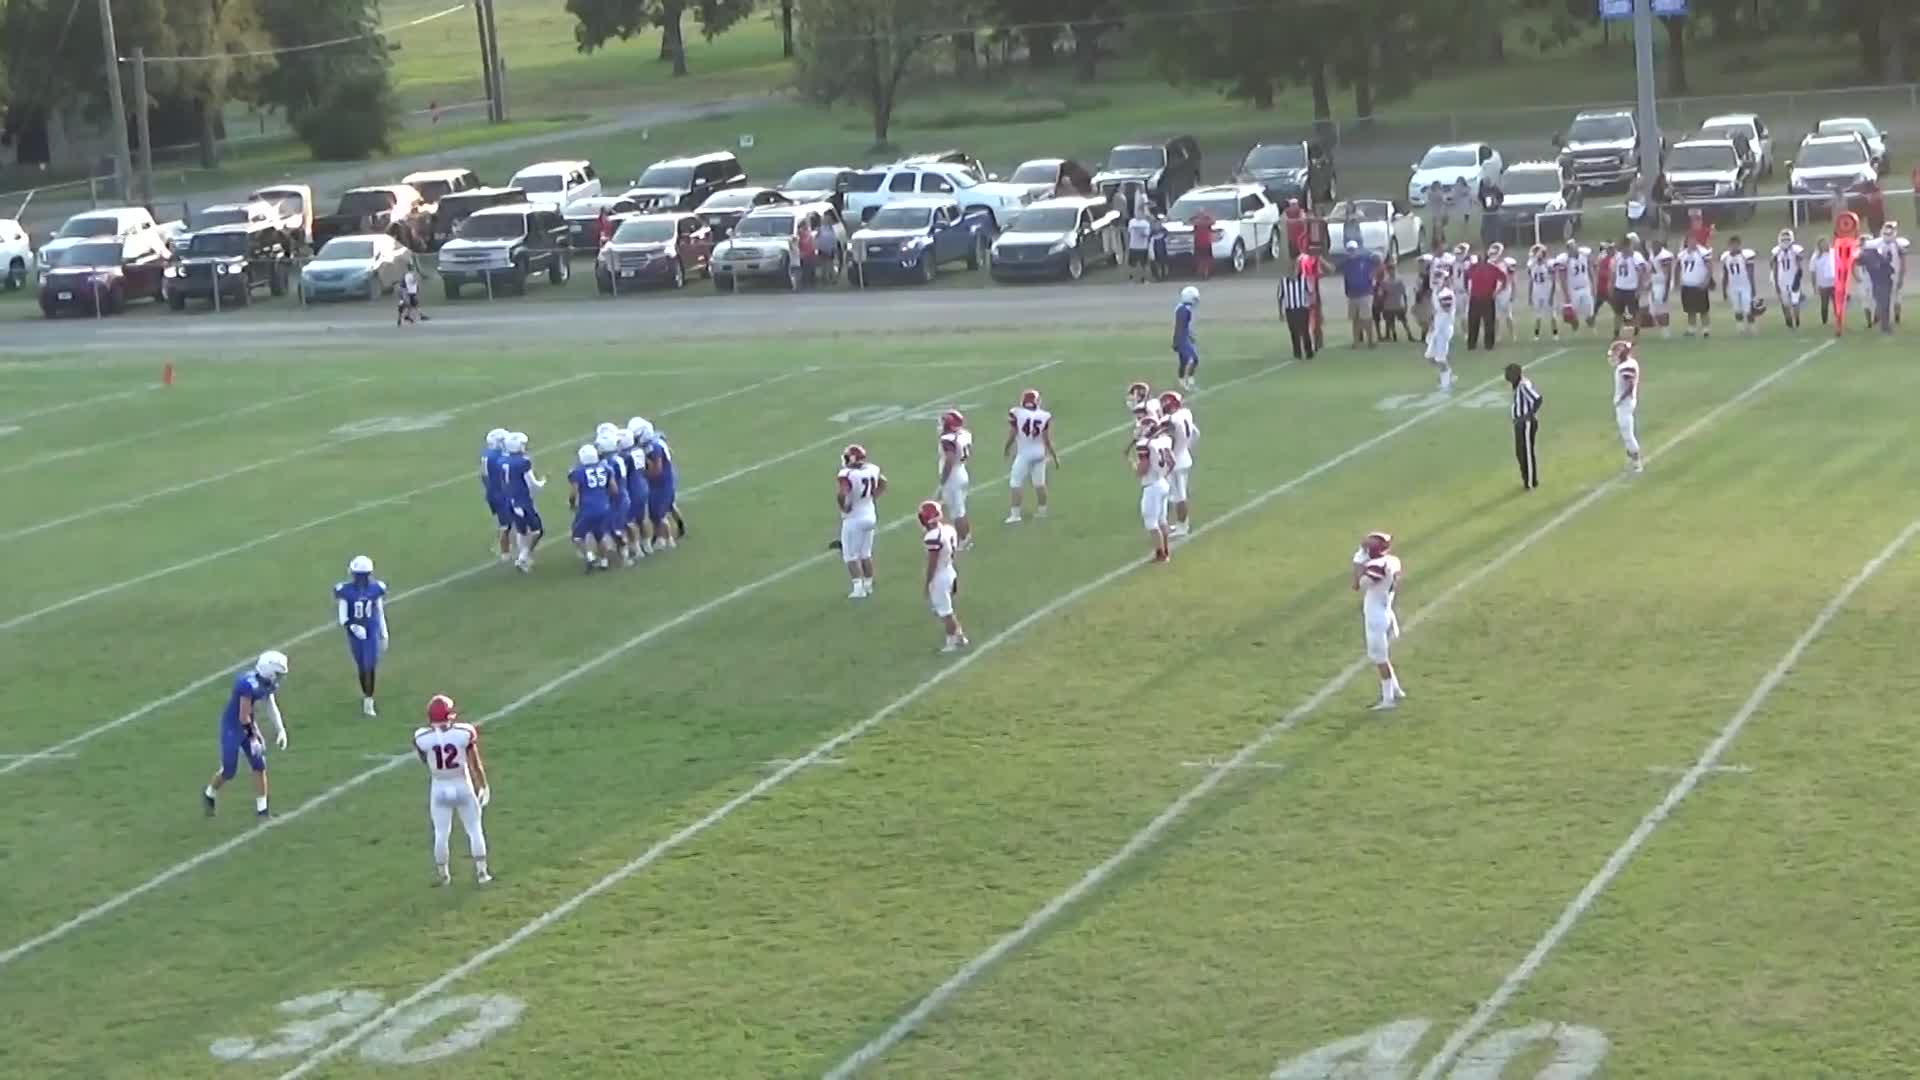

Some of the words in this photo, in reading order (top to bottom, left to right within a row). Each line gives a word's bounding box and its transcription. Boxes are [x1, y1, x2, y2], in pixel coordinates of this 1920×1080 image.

[1021, 418, 1043, 438] 45
[585, 466, 608, 489] 55
[431, 743, 461, 771] 12
[209, 989, 527, 1064] 30
